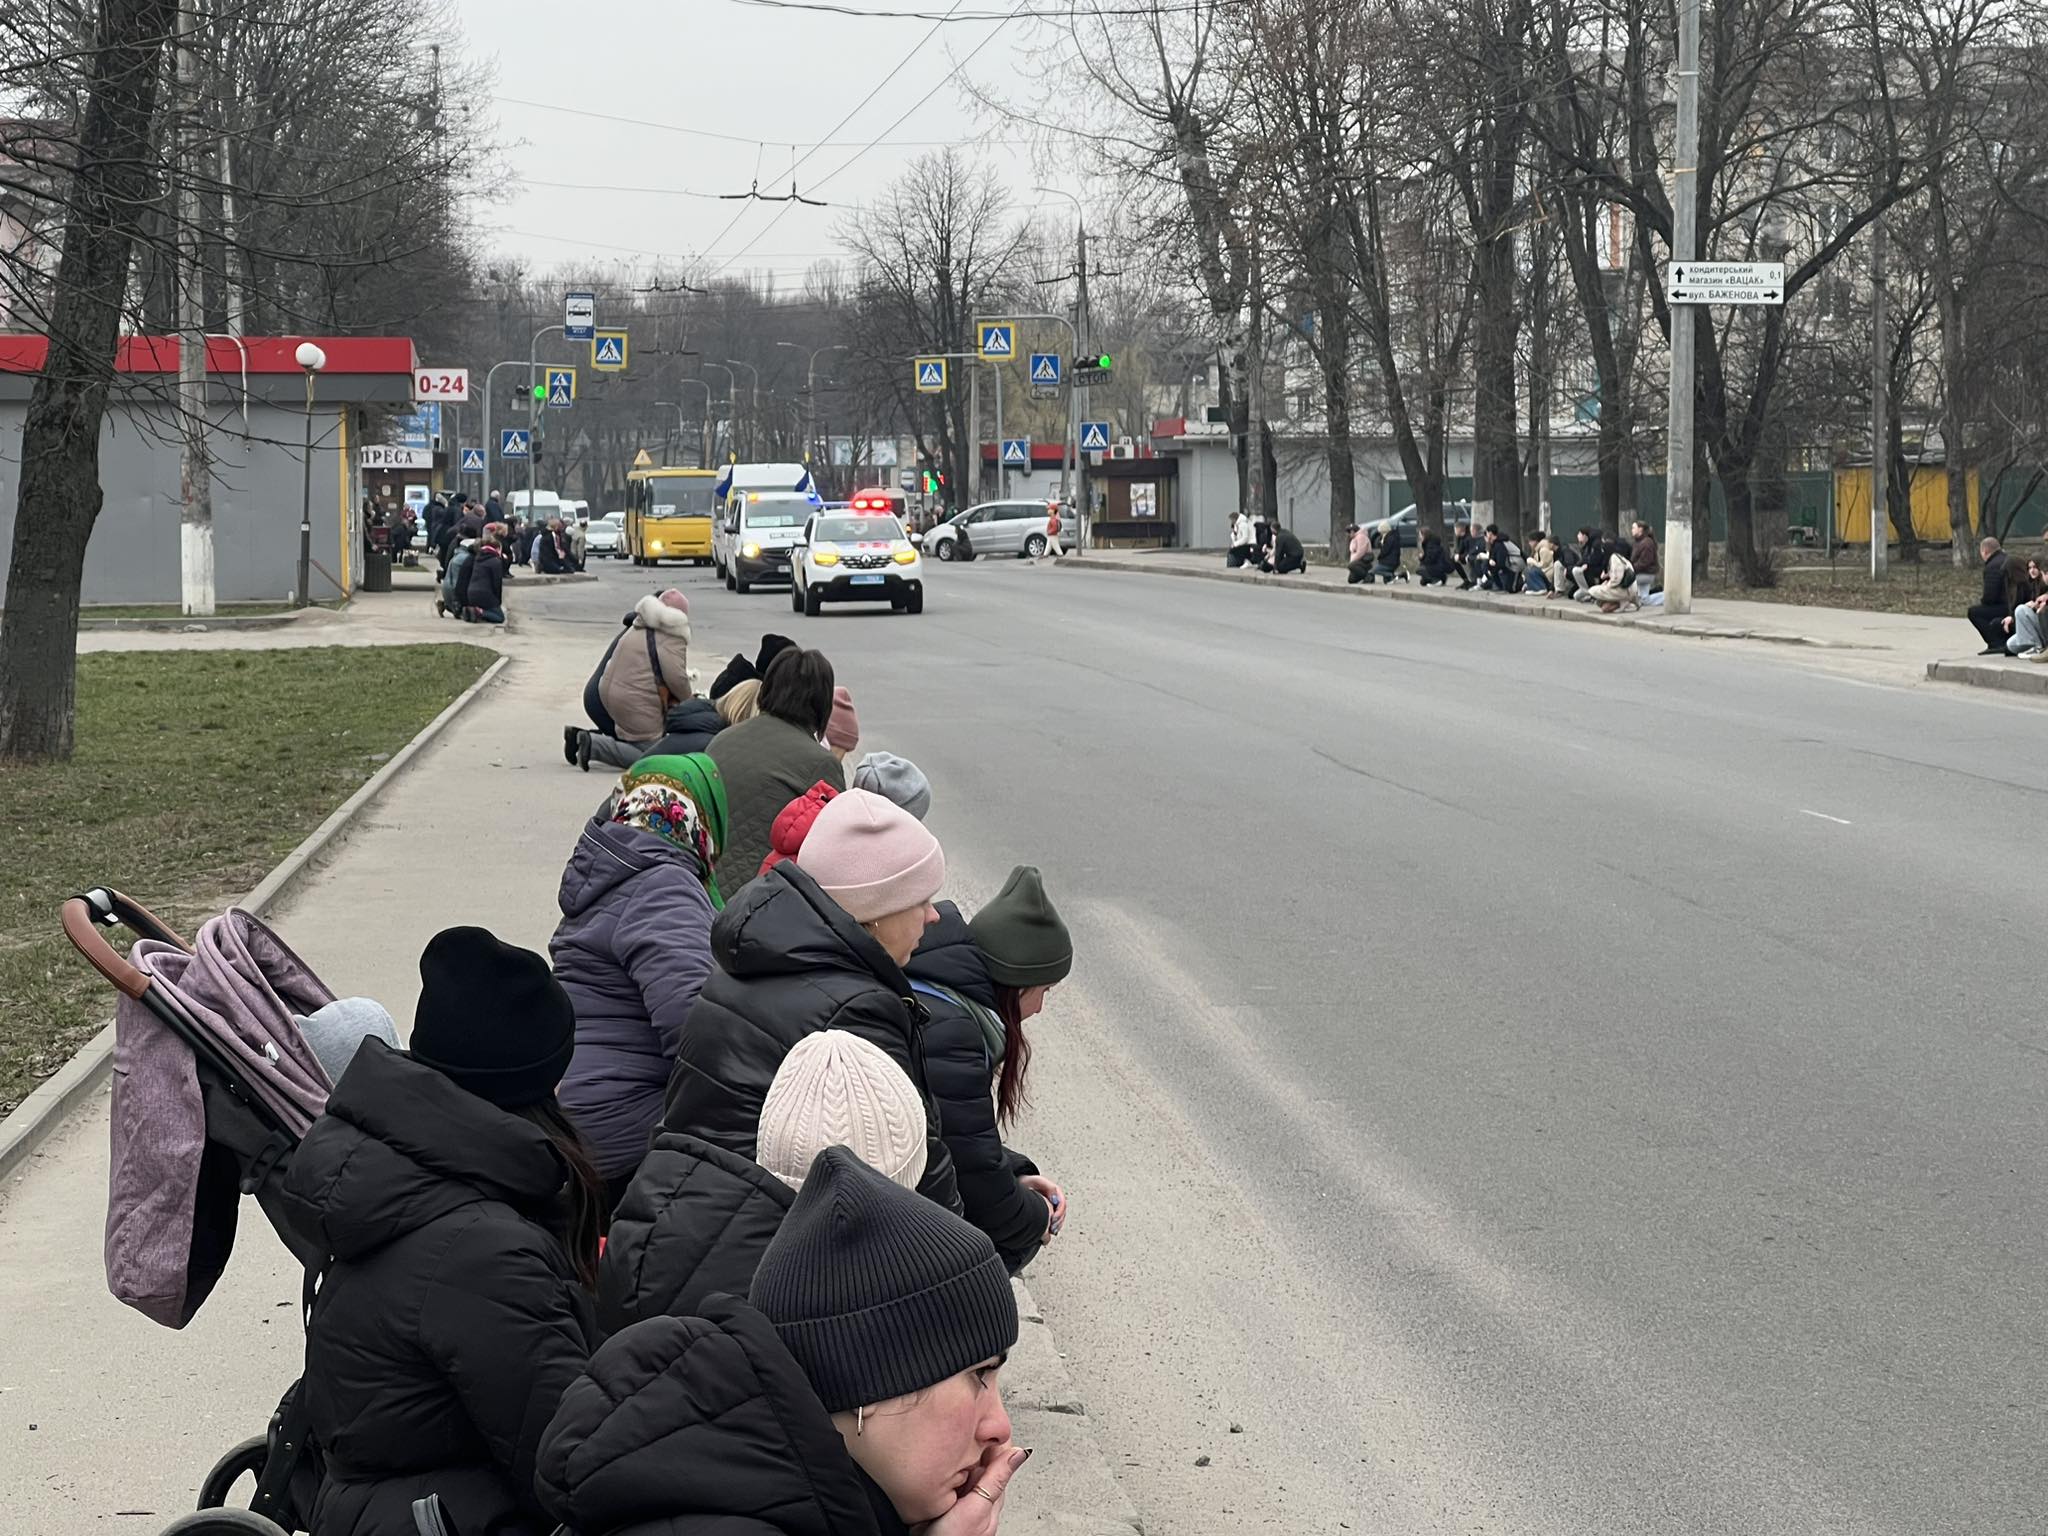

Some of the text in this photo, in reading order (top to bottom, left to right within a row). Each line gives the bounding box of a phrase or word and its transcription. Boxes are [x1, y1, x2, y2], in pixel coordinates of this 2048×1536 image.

[1690, 266, 1753, 275] кондитерський
[1769, 271, 1781, 280] 0,1
[1725, 276, 1764, 285] «ВАЦАК»
[1689, 290, 1759, 300] вул. БАЖЕНОВА
[1079, 372, 1108, 384] СТОП
[419, 376, 464, 393] 0-24
